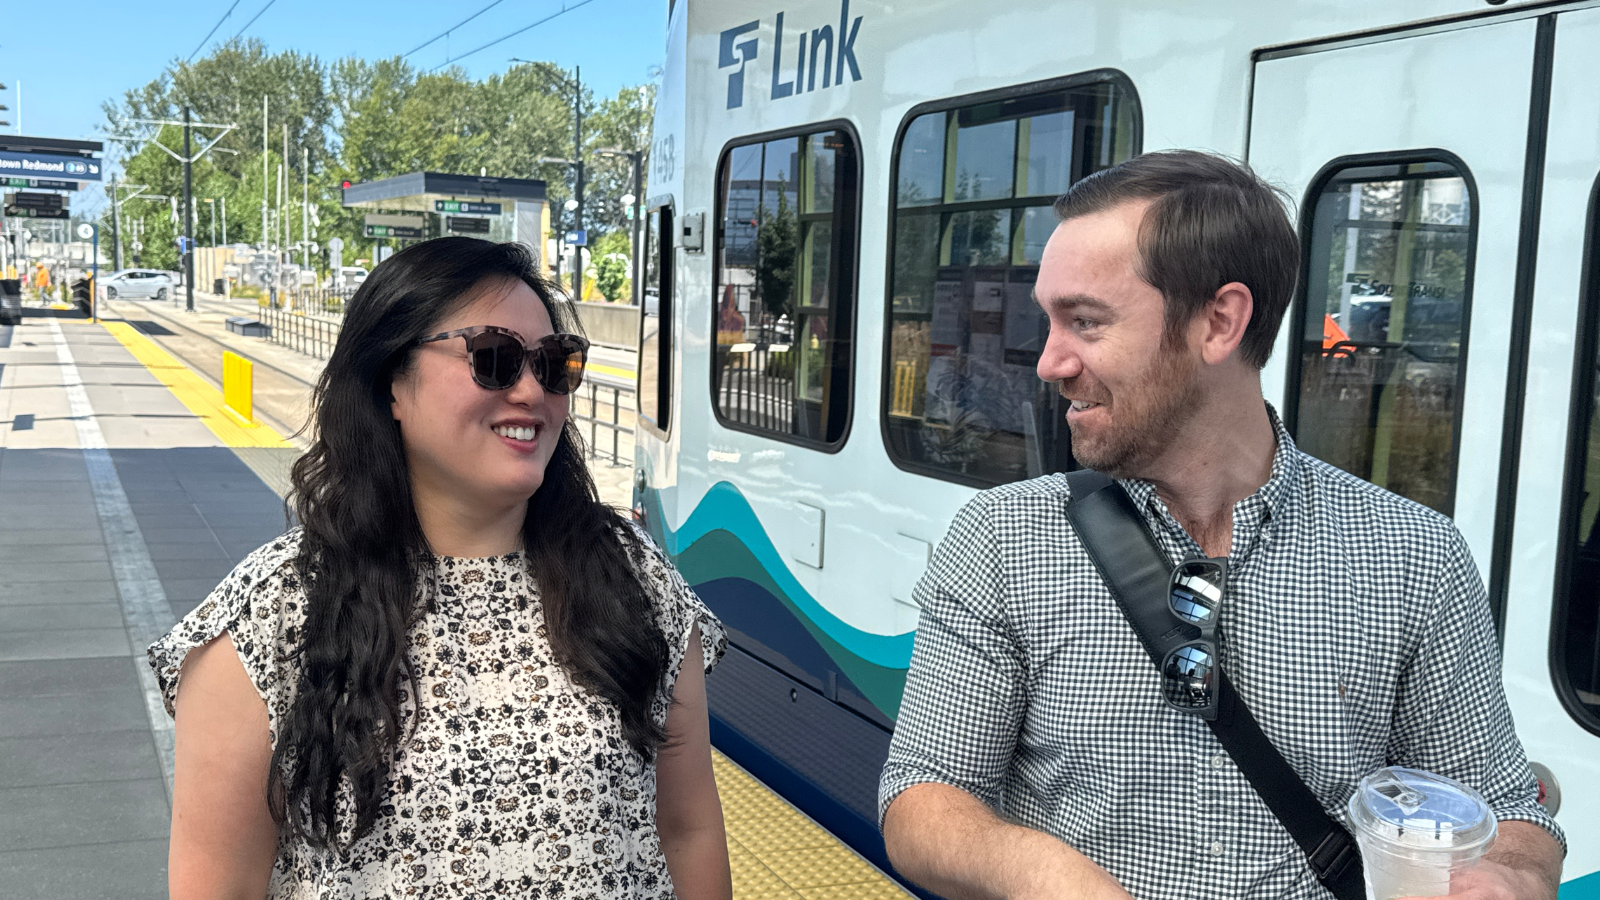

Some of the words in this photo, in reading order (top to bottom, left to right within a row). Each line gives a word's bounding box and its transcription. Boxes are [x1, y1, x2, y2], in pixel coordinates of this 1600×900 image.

[770, 0, 864, 101] Link
[22, 158, 64, 172] Redmond
[444, 203, 459, 211] EXIT
[374, 227, 387, 235] EXIT
